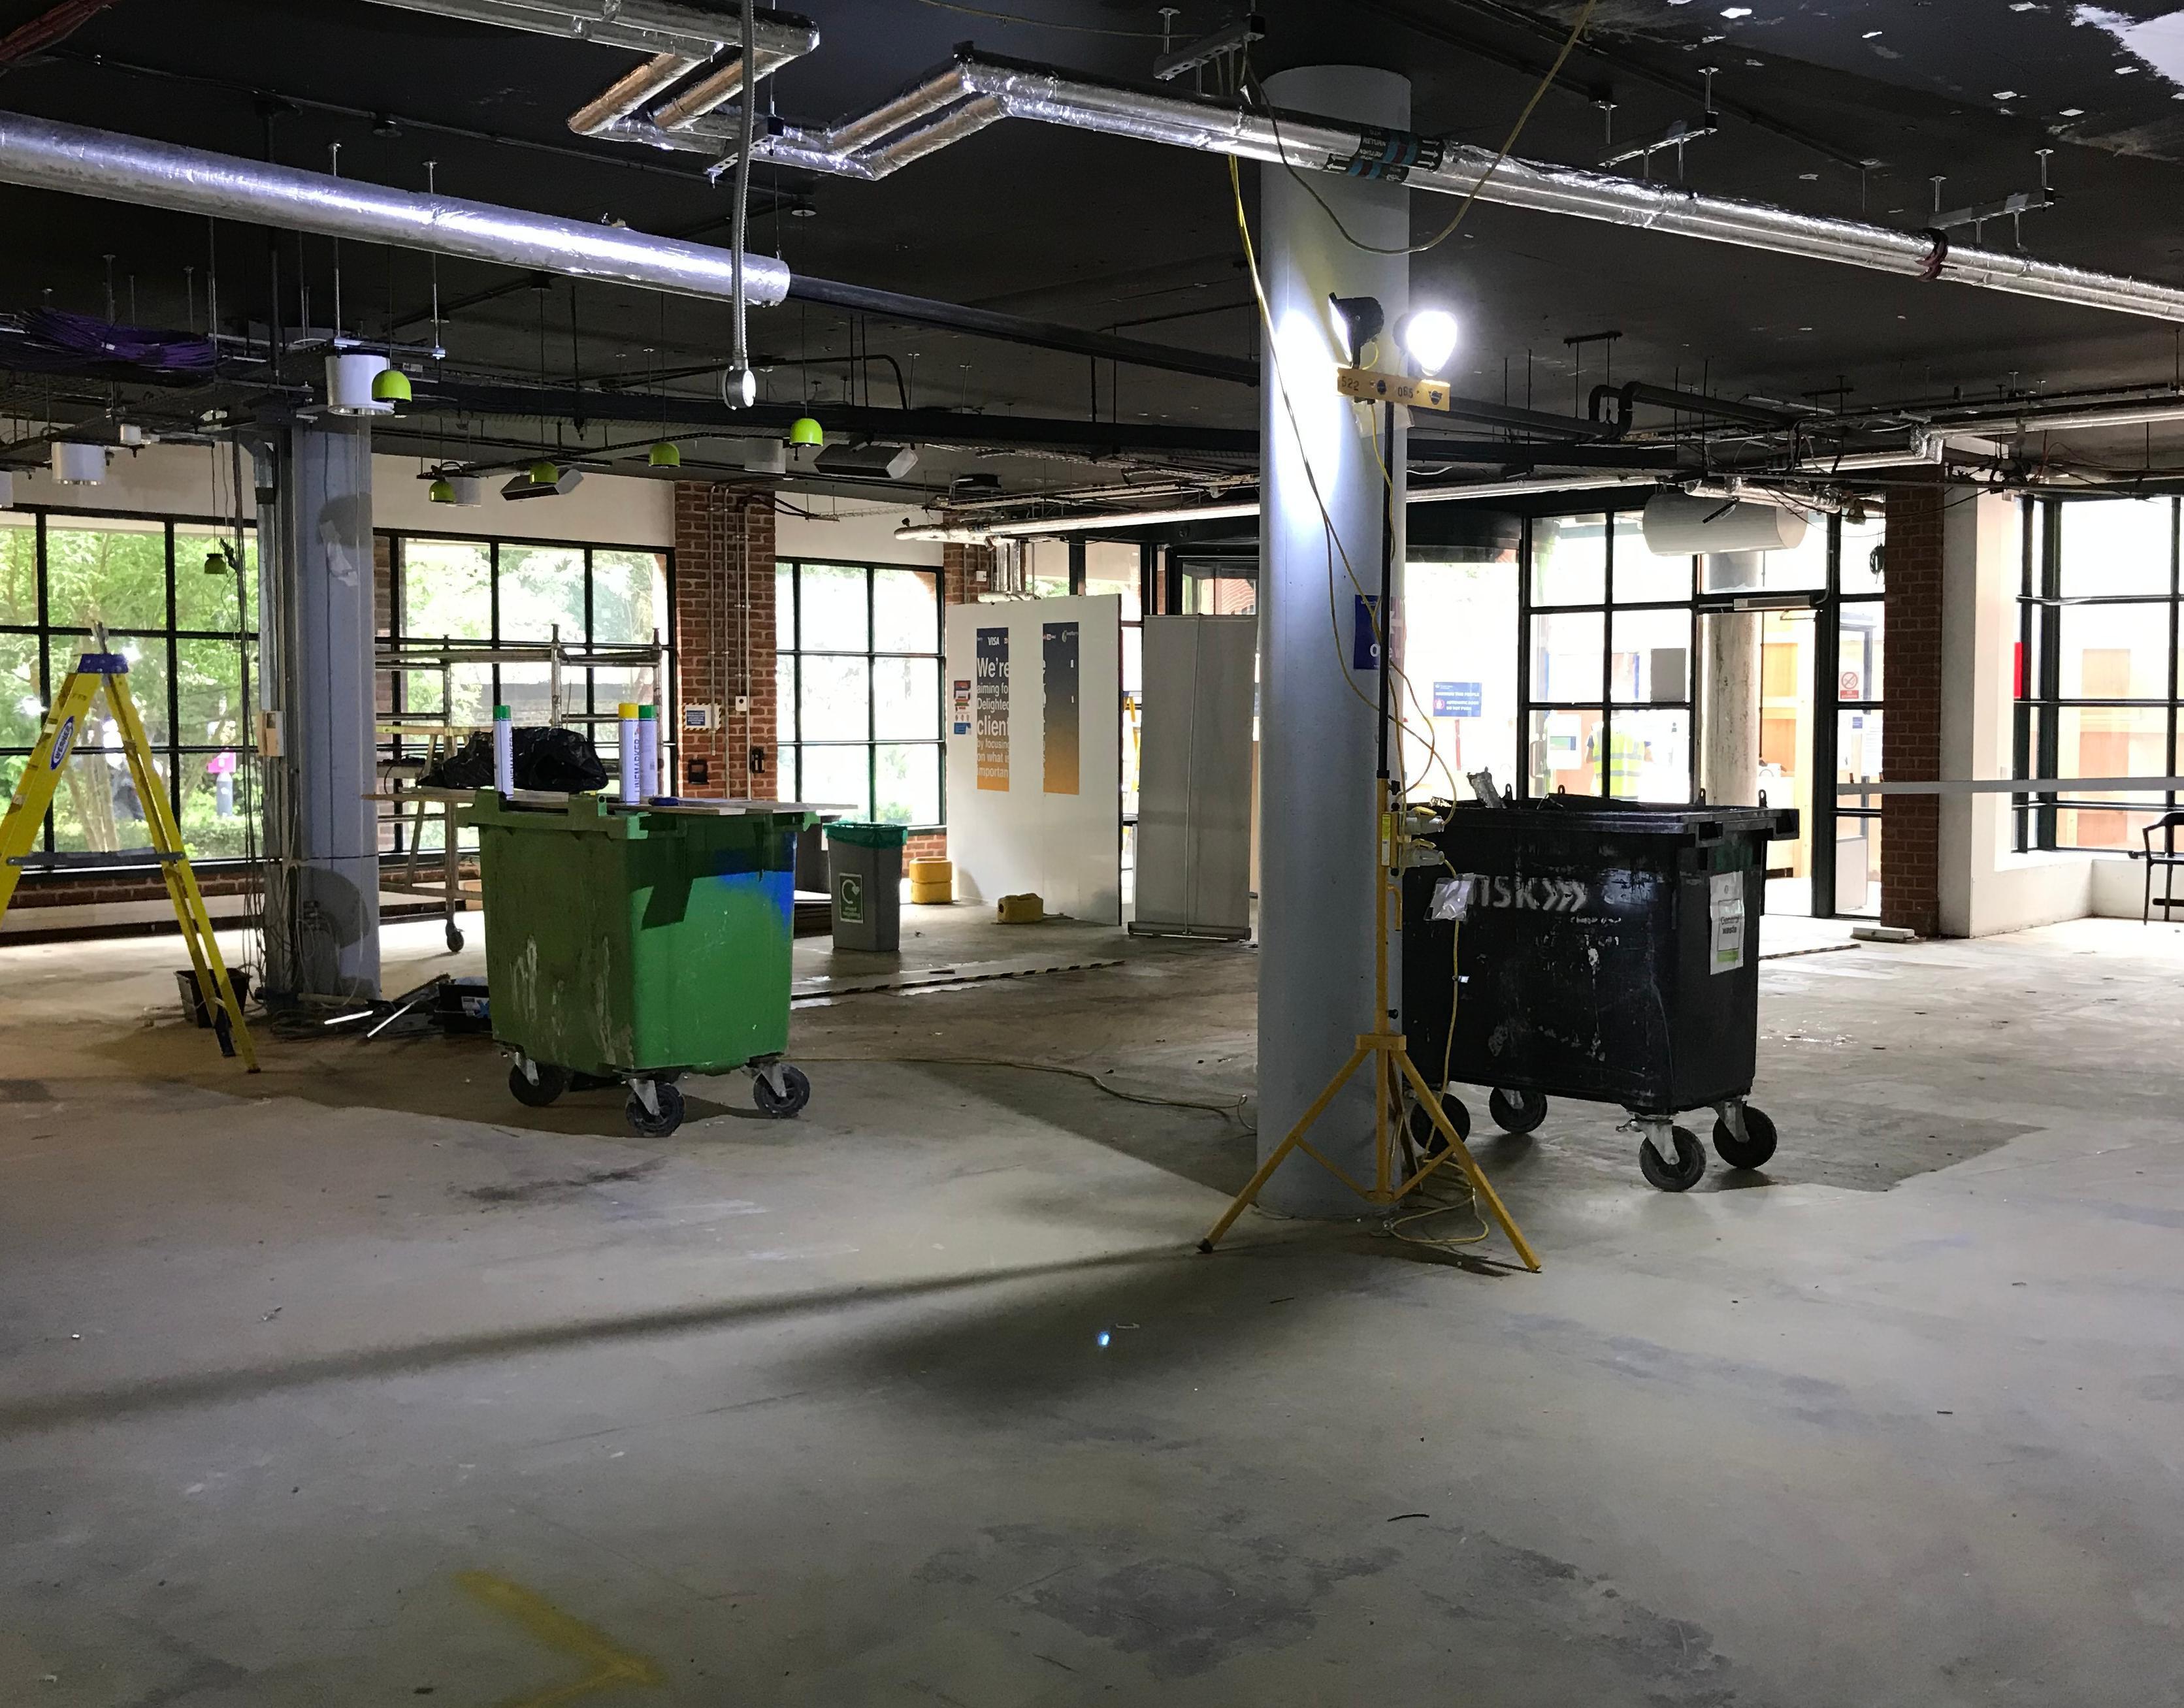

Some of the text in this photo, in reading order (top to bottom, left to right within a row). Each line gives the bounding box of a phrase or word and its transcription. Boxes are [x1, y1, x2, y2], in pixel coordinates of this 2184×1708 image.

[1363, 138, 1386, 146] RETURN
[1341, 376, 1360, 391] 522
[988, 637, 1000, 645] VISA
[977, 683, 999, 697] aiming
[987, 752, 1003, 763] what
